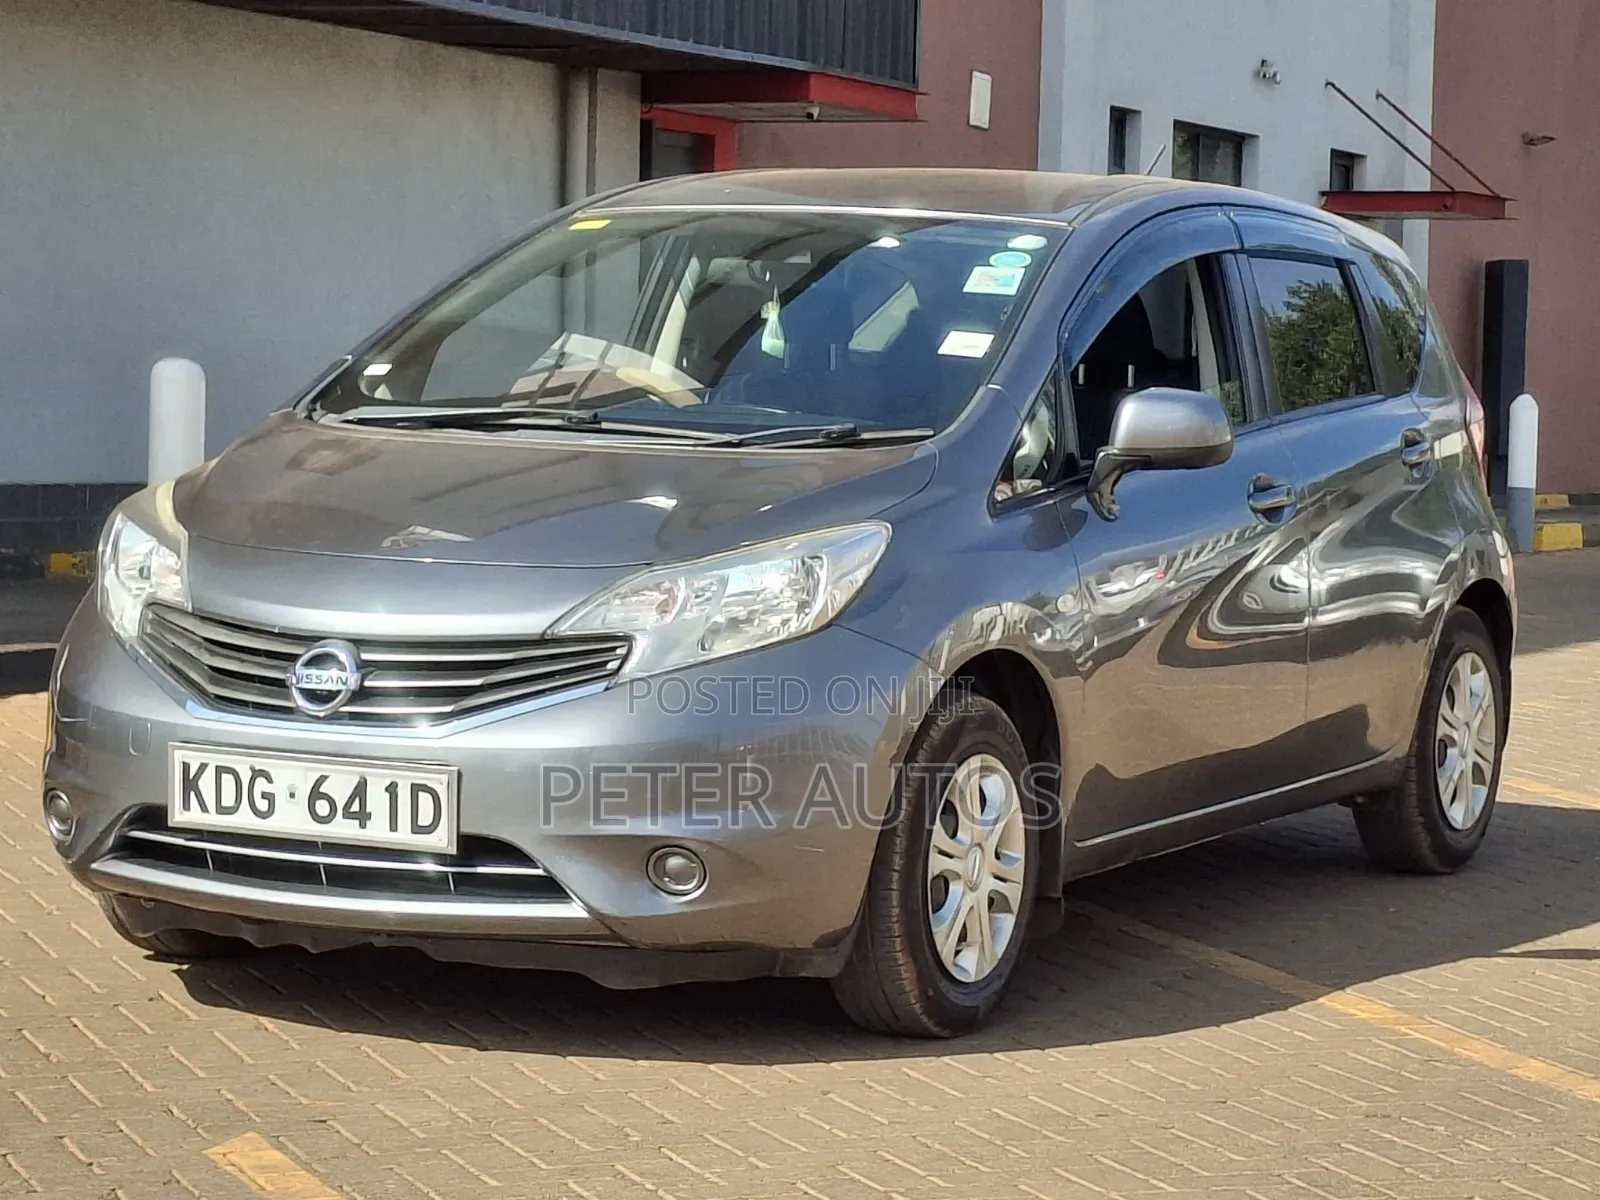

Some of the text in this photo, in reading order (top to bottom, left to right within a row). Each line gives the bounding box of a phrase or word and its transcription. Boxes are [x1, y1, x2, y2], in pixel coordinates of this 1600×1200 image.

[295, 672, 349, 686] NISSAN
[181, 761, 442, 835] KDG 641D
